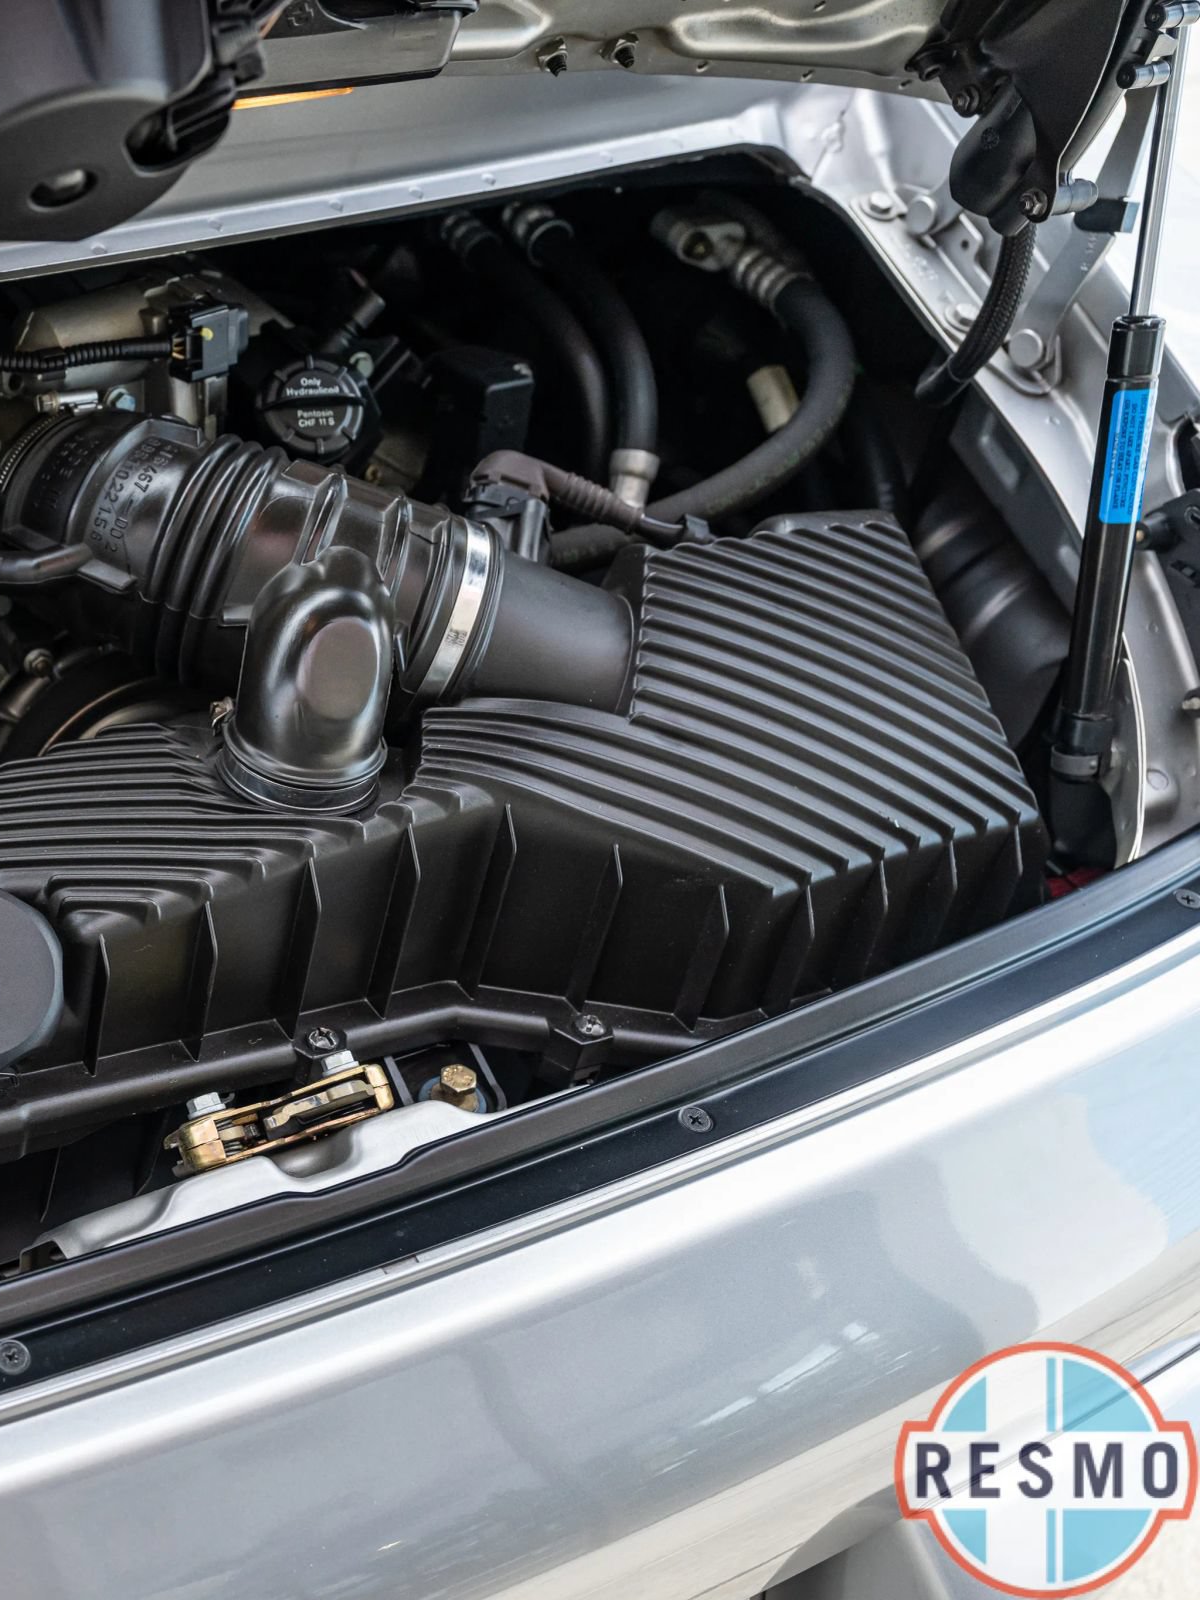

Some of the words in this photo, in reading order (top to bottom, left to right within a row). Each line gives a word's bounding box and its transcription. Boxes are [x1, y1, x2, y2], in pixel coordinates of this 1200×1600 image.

[300, 377, 322, 387] Only
[297, 410, 334, 419] Pentosin
[298, 418, 316, 428] CHF
